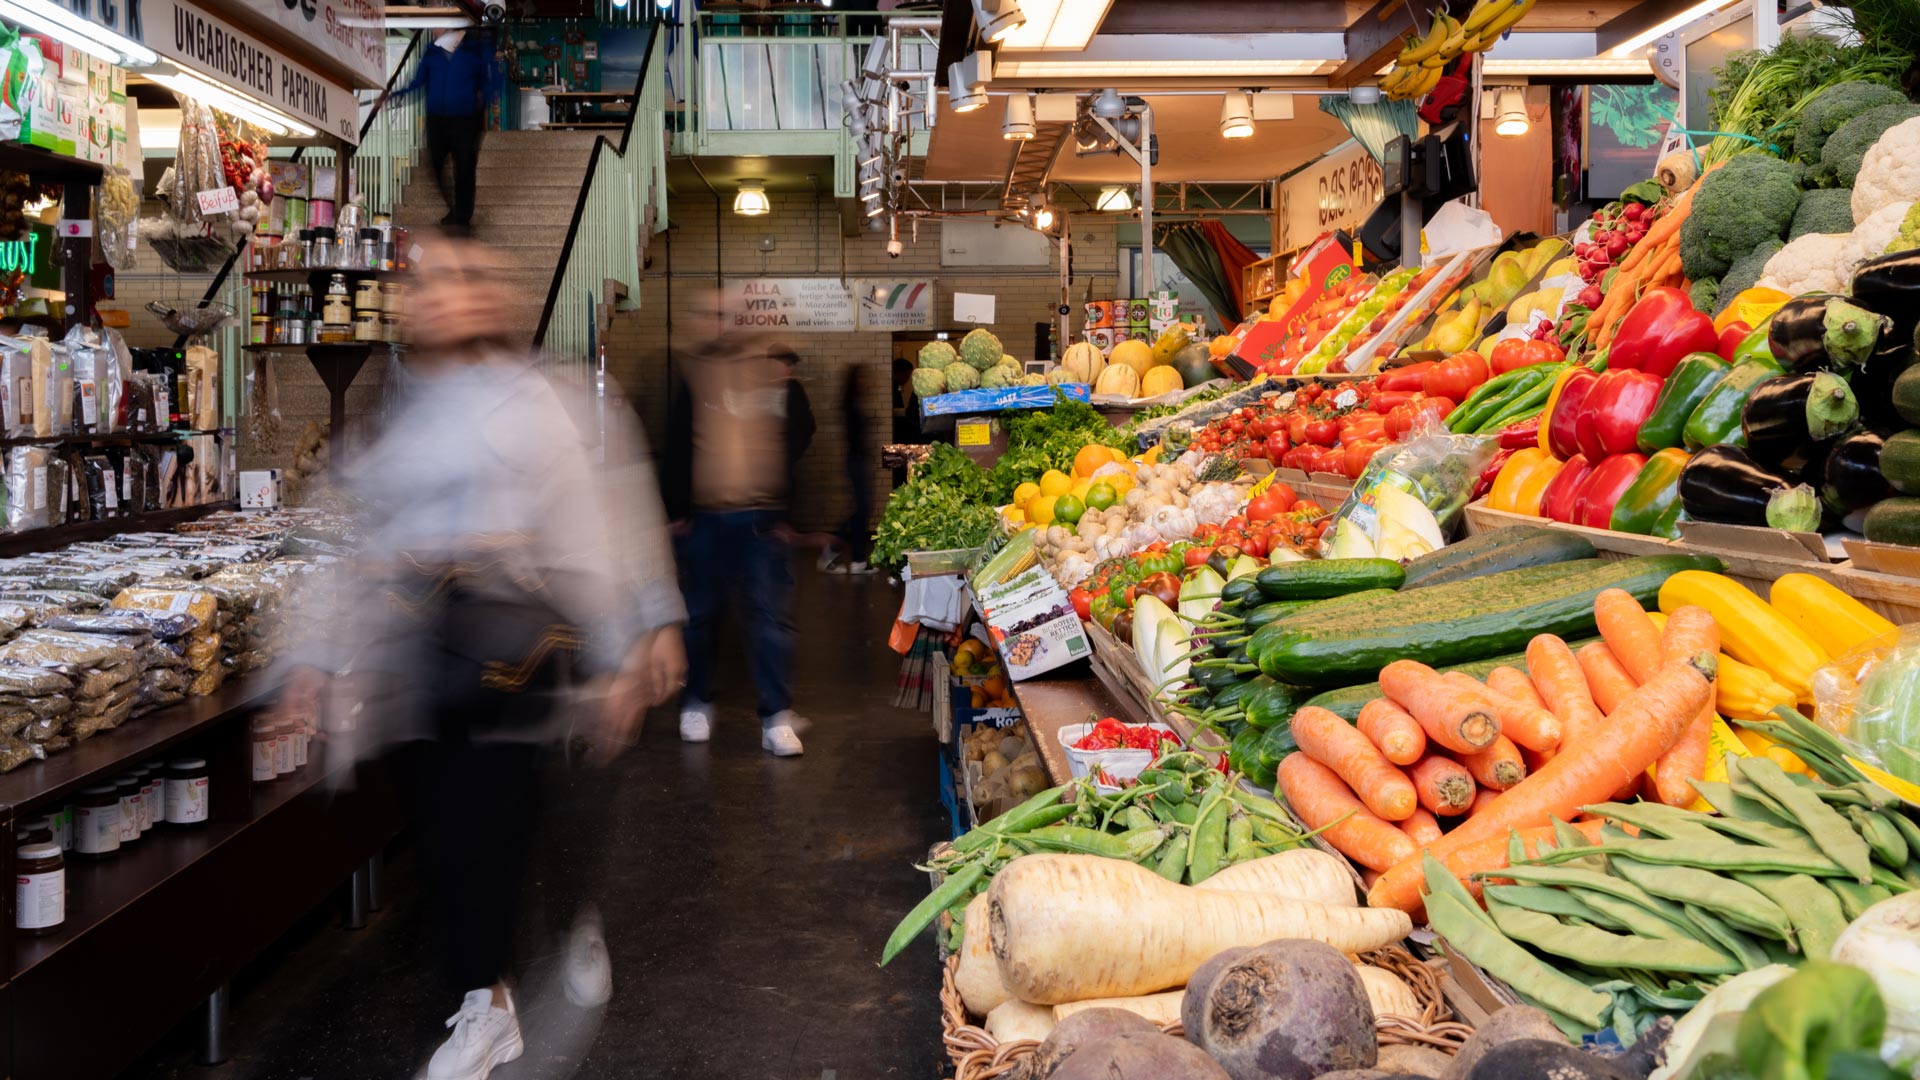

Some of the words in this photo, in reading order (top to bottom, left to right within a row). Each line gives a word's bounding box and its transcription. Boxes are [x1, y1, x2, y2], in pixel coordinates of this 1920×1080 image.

[325, 5, 354, 49] Stand
[1659, 44, 1669, 53] 9
[173, 5, 274, 97] UNGARISCHER
[281, 63, 328, 123] PAPRIKA
[1662, 58, 1672, 67] 8
[1319, 166, 1346, 226] DAS
[743, 284, 781, 296] ALLA
[801, 283, 826, 291] frische
[798, 292, 824, 301] fertige
[826, 292, 853, 300] Saucen
[745, 298, 778, 311] VITA
[805, 301, 847, 309] Mozzarella
[734, 313, 789, 327] BUONA
[814, 310, 838, 318] Weine
[796, 318, 811, 327] und
[813, 318, 834, 327] vieles
[1053, 616, 1076, 630] ROTER
[1050, 621, 1079, 638] RETTICH
